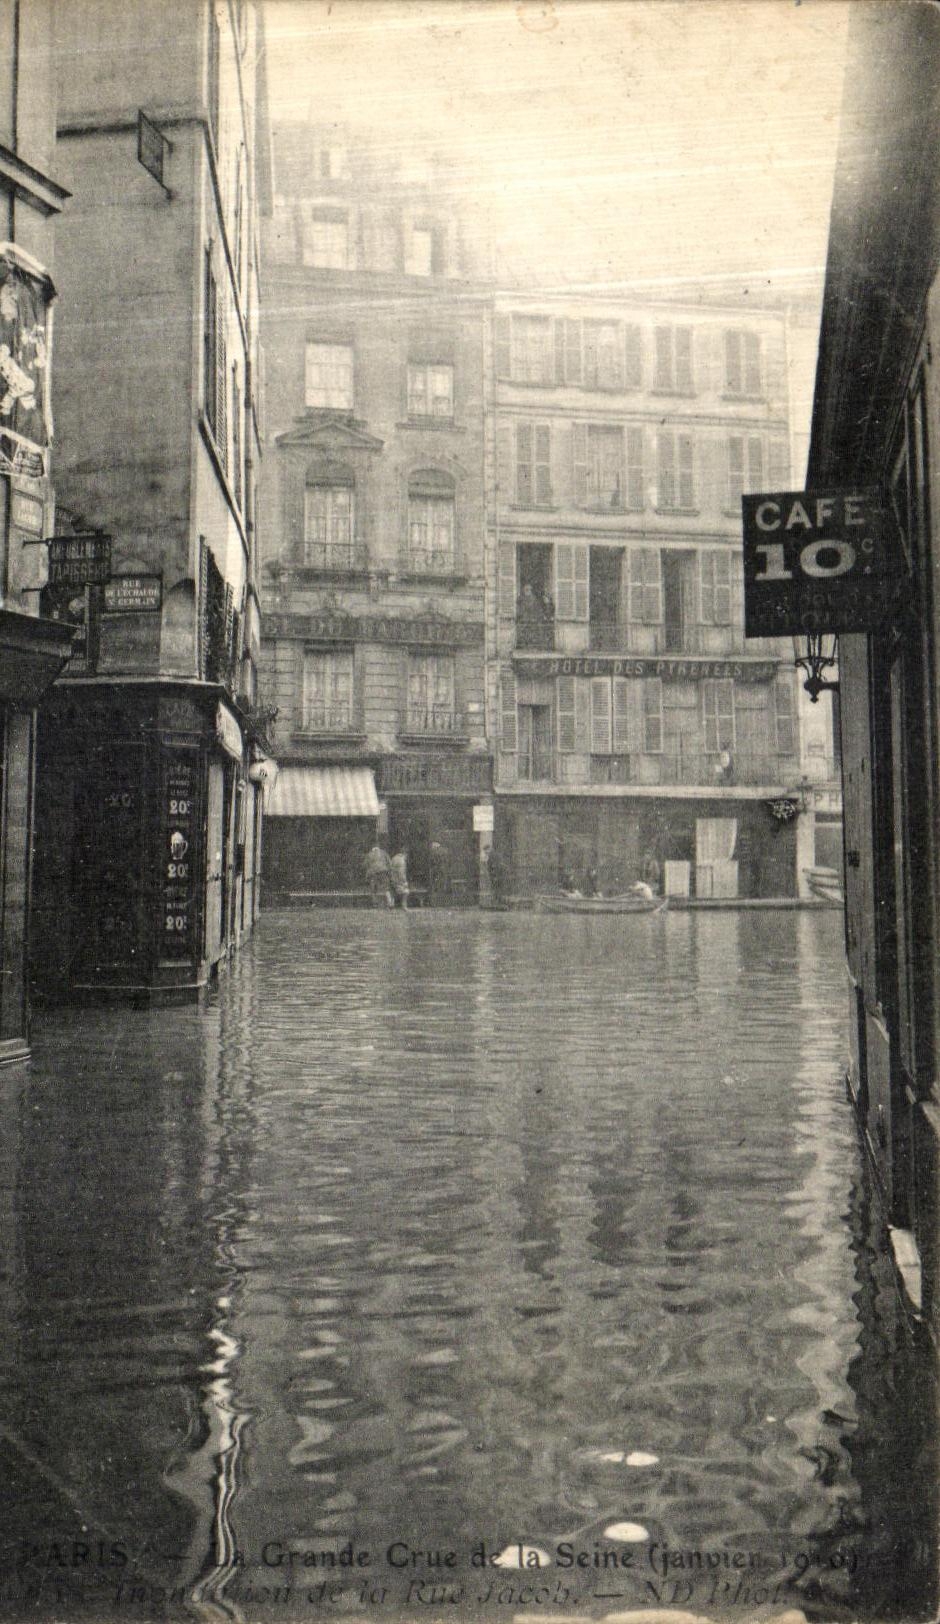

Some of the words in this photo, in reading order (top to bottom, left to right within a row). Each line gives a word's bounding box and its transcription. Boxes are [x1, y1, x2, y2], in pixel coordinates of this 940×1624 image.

[122, 579, 141, 588] RUE
[118, 597, 156, 606] GERMAIN
[614, 660, 644, 675] DES
